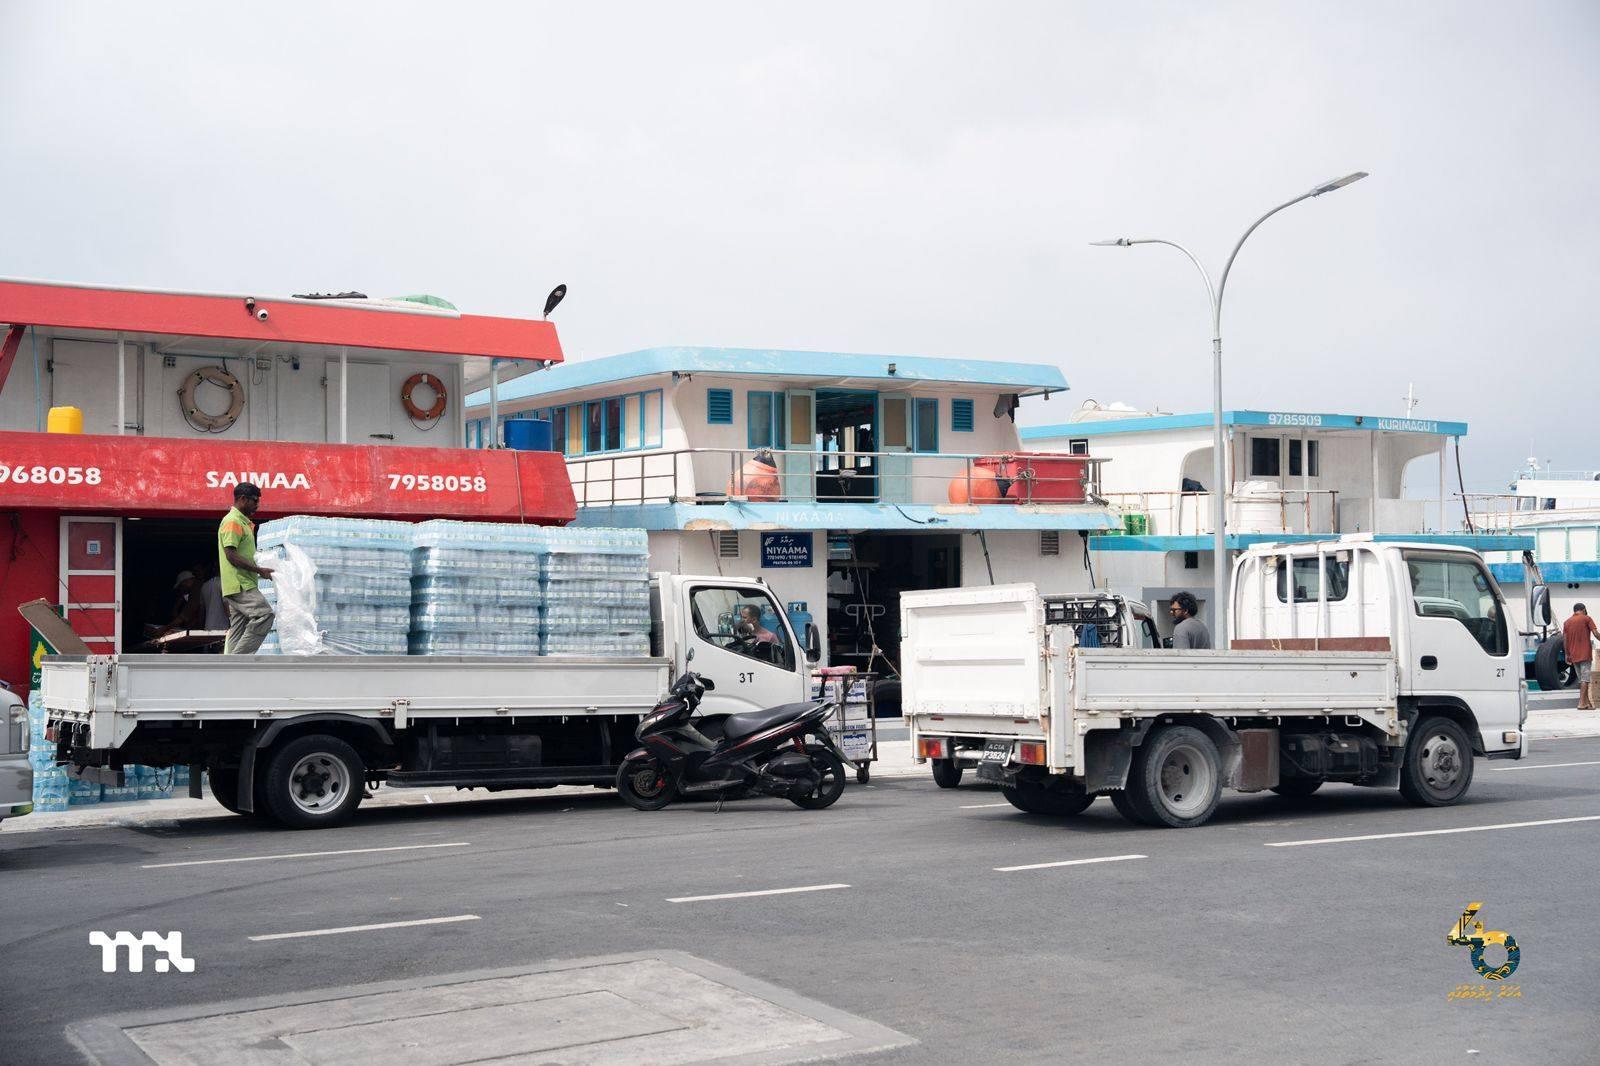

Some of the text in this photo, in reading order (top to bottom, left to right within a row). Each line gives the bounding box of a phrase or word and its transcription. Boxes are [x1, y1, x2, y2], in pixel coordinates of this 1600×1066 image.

[1269, 414, 1321, 426] 9785909
[1378, 418, 1430, 431] KURIMAGU
[206, 471, 311, 489] SAIMAA
[387, 474, 487, 492] 7958058
[766, 546, 808, 554] NIYAAMA
